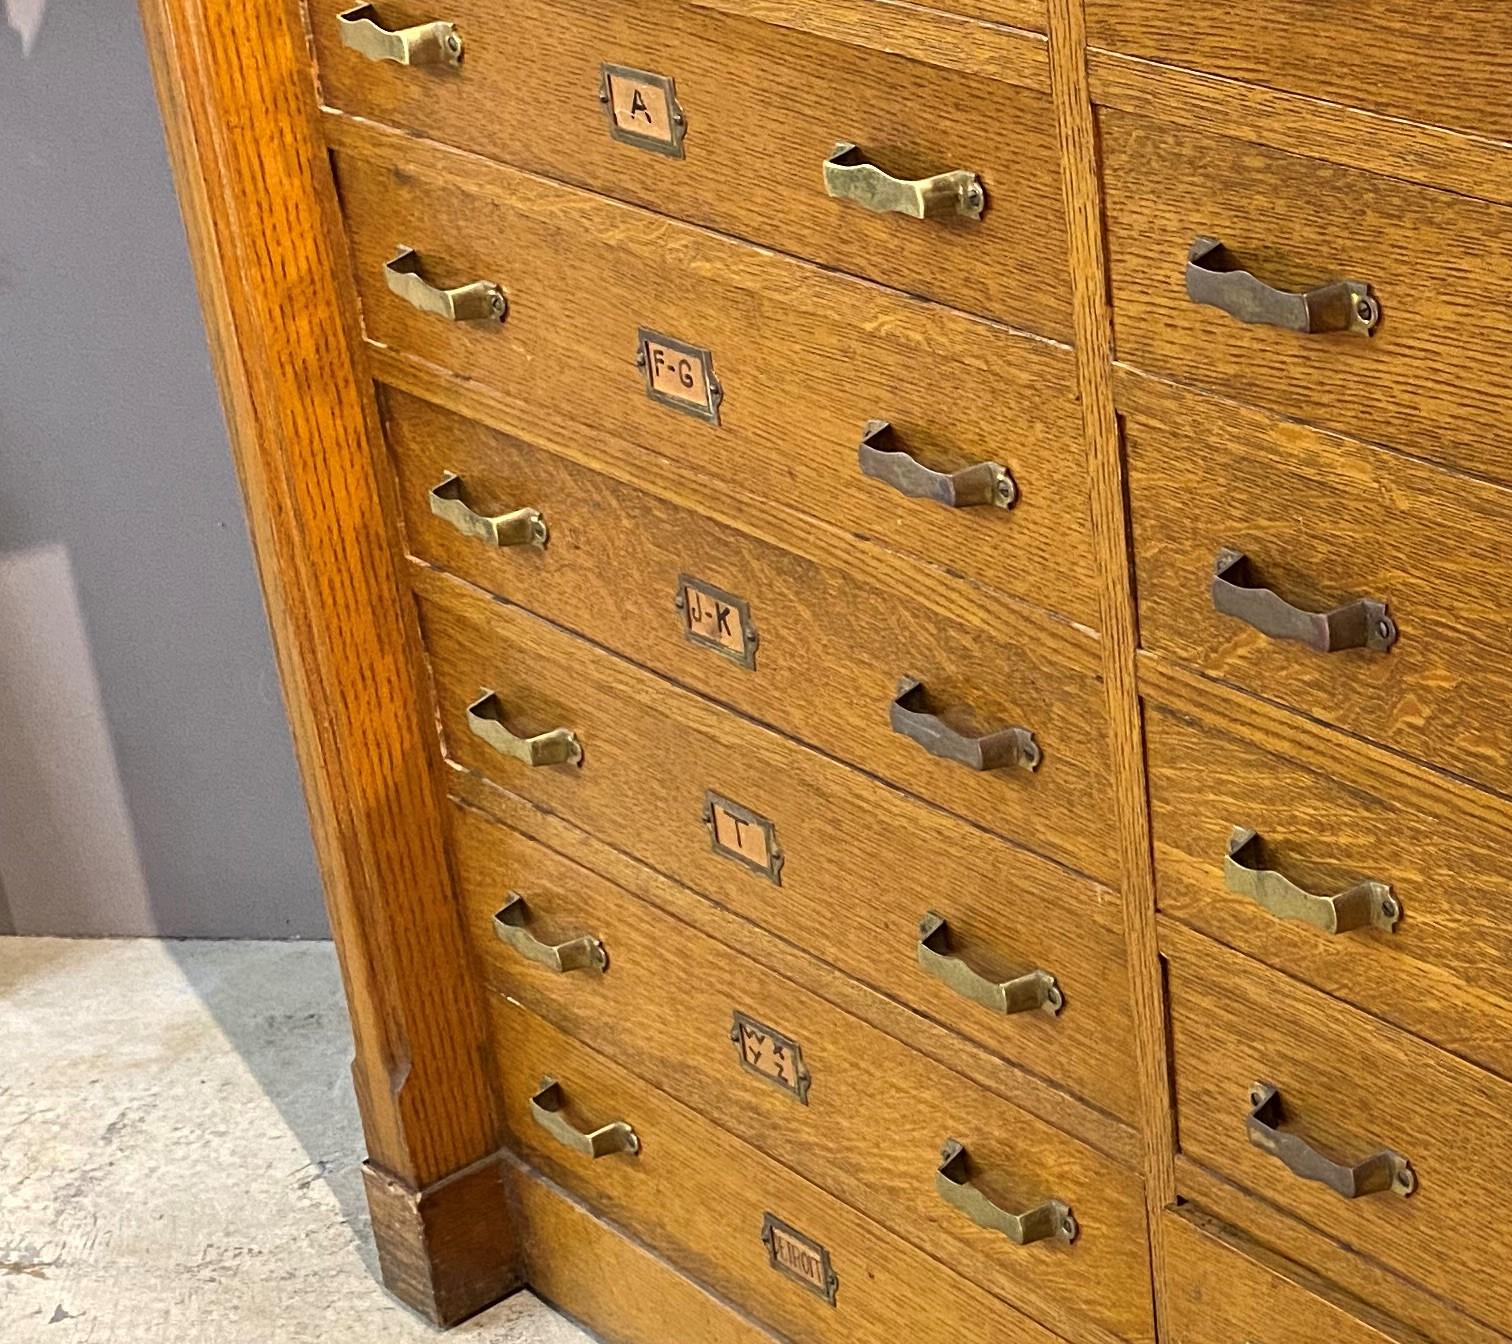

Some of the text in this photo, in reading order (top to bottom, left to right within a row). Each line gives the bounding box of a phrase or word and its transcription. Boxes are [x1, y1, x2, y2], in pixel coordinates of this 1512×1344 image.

[631, 89, 652, 124] A
[653, 349, 694, 388] F-G
[692, 592, 732, 637] J-K
[723, 809, 749, 848] T
[748, 1045, 762, 1065] Y
